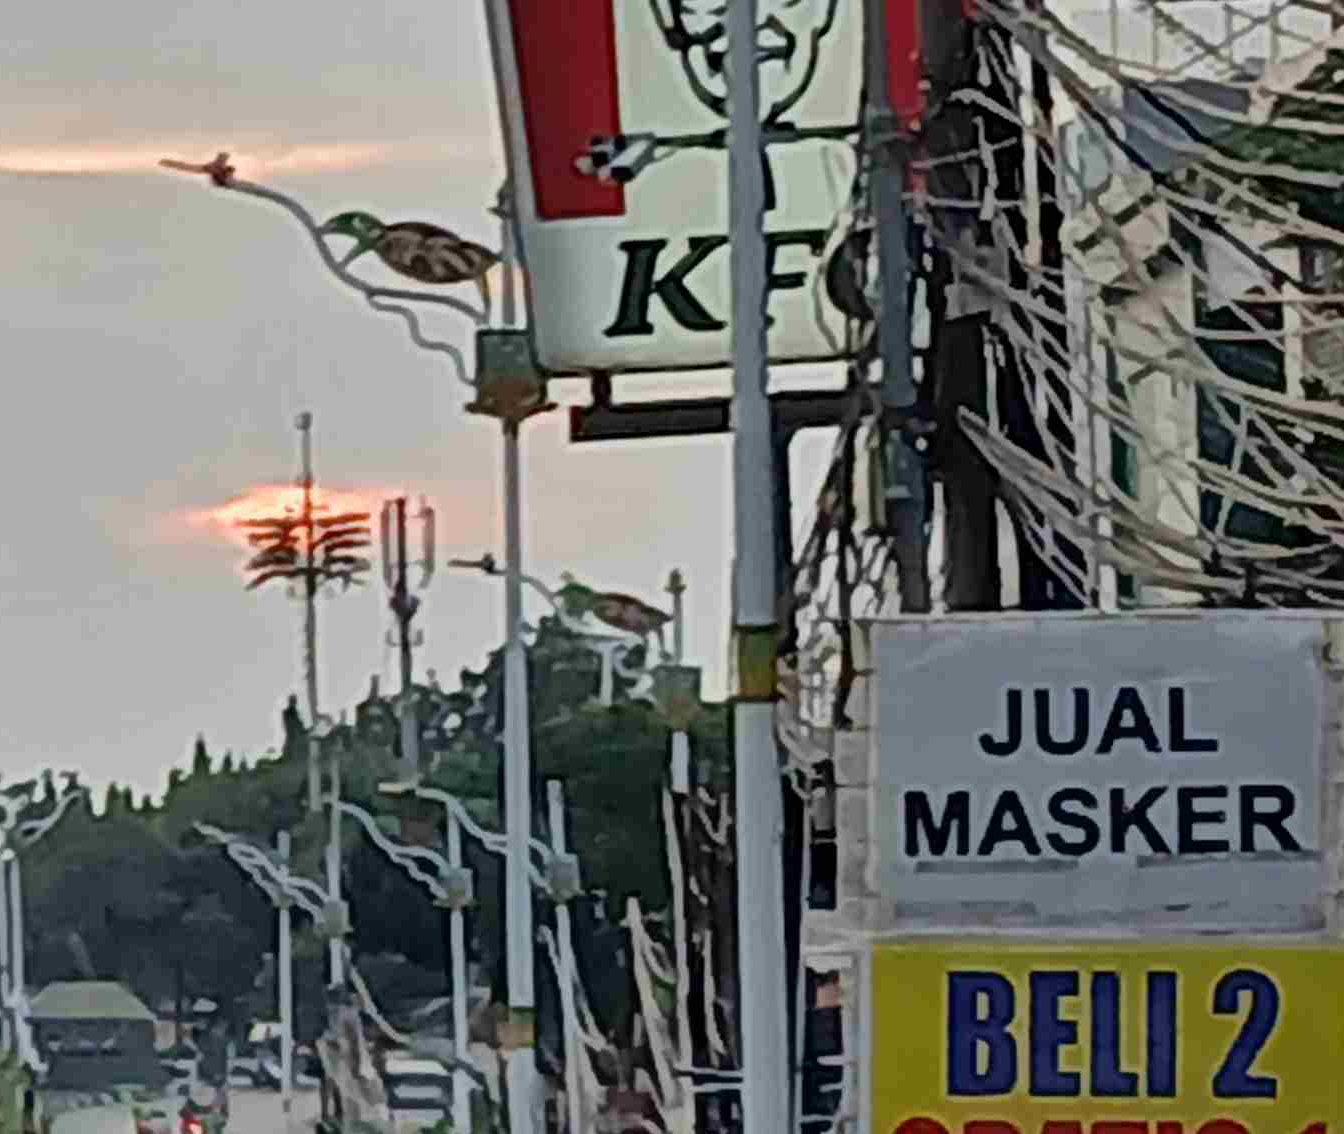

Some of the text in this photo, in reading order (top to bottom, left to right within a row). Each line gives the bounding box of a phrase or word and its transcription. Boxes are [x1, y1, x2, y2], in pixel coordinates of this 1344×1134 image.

[979, 687, 1219, 756] JUAL
[903, 784, 1302, 857] MASKER
[946, 968, 1282, 1099] BELI 2
